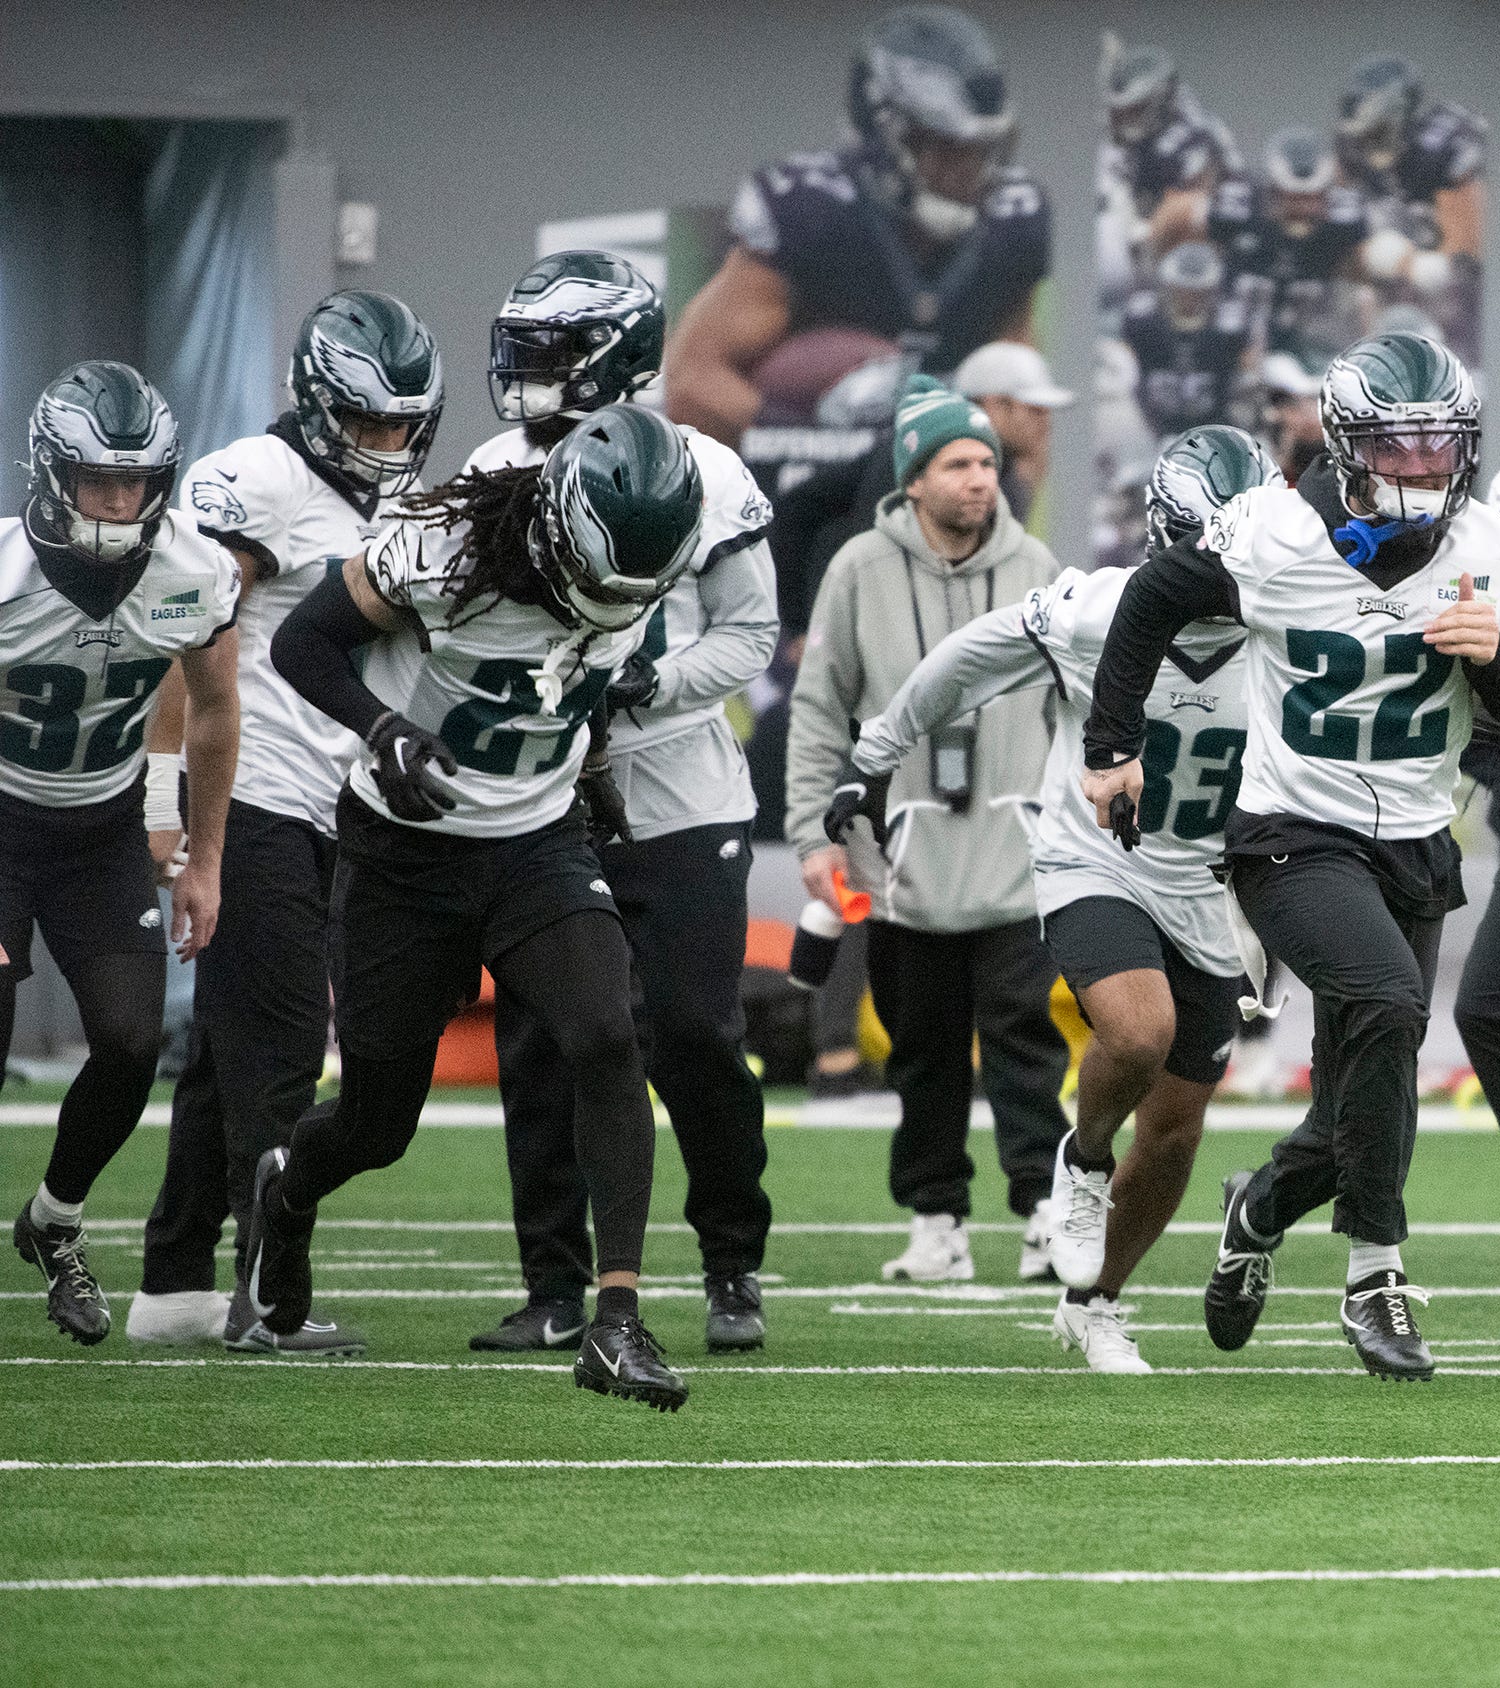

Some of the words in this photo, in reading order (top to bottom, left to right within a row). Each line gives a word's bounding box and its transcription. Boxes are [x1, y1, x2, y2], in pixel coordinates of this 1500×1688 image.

[151, 607, 186, 620] EAGLES
[1355, 597, 1409, 620] EAGLES
[72, 630, 125, 648] EAGLES
[1282, 628, 1455, 761] 22
[0, 657, 173, 773] 32
